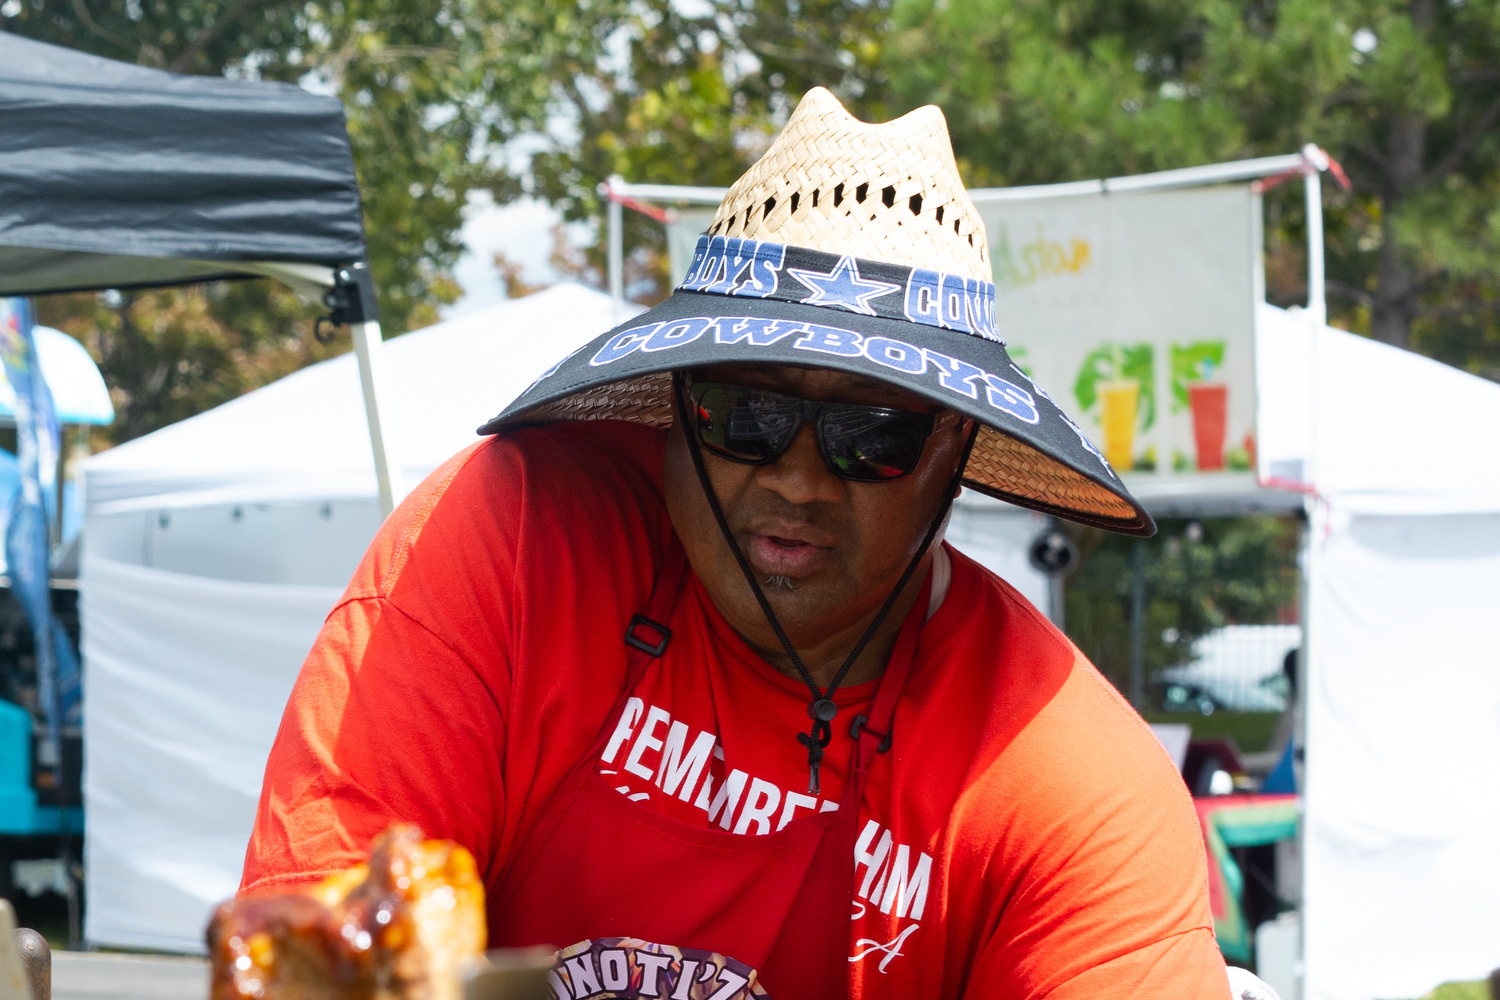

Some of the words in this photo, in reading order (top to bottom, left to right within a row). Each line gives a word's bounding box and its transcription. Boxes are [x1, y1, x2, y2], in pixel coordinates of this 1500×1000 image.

[904, 267, 1006, 347] COW
[589, 315, 1040, 425] COWBOYS
[600, 696, 840, 836] REMEMB
